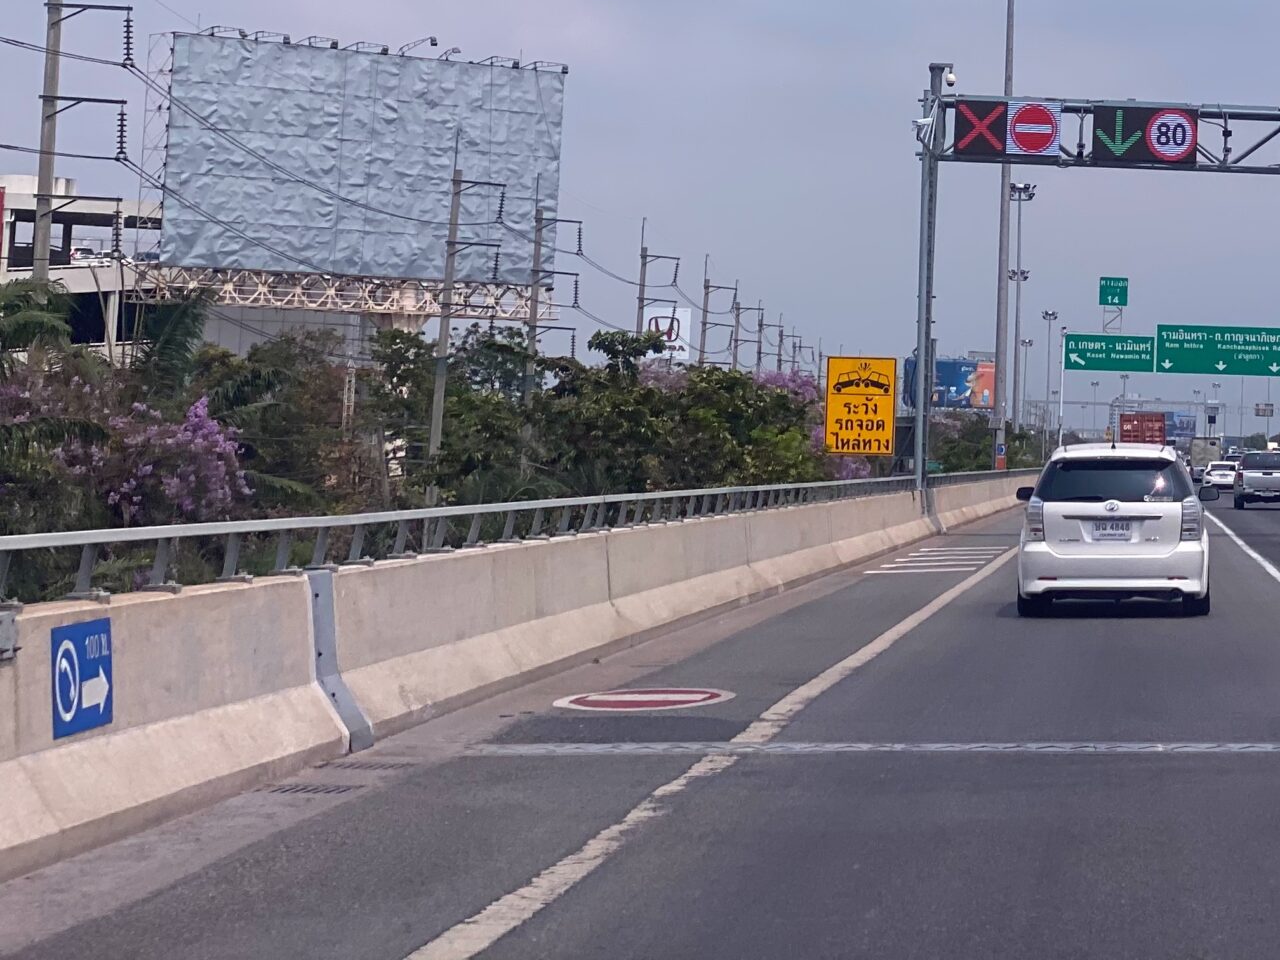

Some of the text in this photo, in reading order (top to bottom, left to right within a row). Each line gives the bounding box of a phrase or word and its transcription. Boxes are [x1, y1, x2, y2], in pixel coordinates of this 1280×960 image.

[1156, 122, 1186, 147] 80
[1107, 295, 1119, 304] 14
[843, 396, 878, 416] ระวัง
[834, 418, 885, 432] รถจอด
[830, 431, 890, 452] ไหล่ทาง
[85, 634, 100, 659] 100
